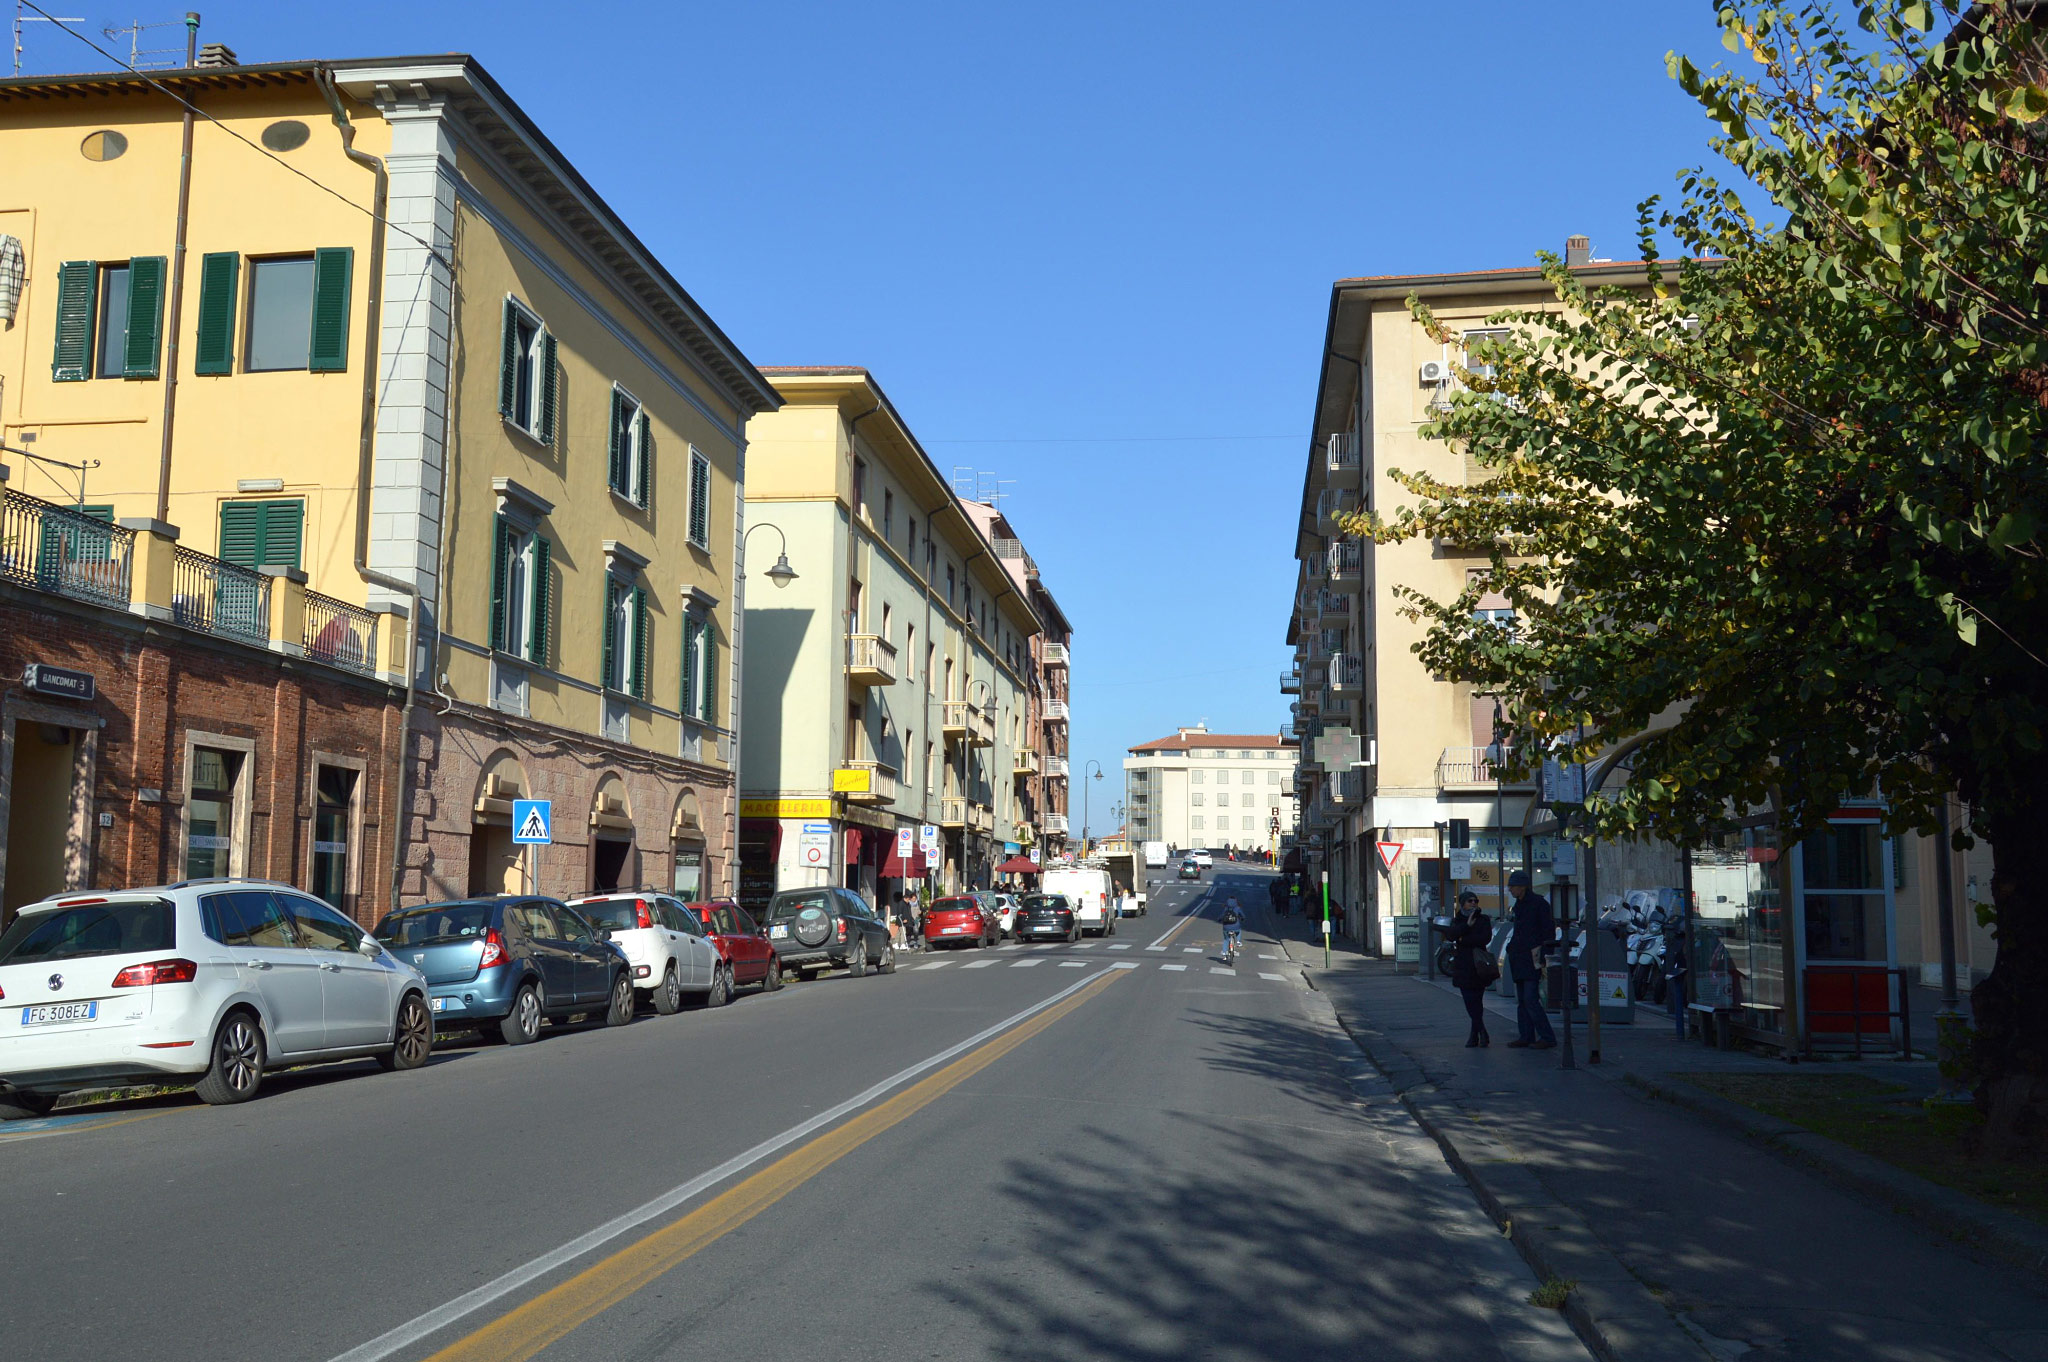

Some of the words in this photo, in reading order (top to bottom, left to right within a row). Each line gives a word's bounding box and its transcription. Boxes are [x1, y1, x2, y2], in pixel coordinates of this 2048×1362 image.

[42, 673, 78, 689] BANCOMAT
[743, 803, 824, 813] MACELLERIA
[1271, 807, 1280, 835] BAR
[30, 1008, 46, 1022] FG
[50, 1003, 89, 1020] 308EZ
